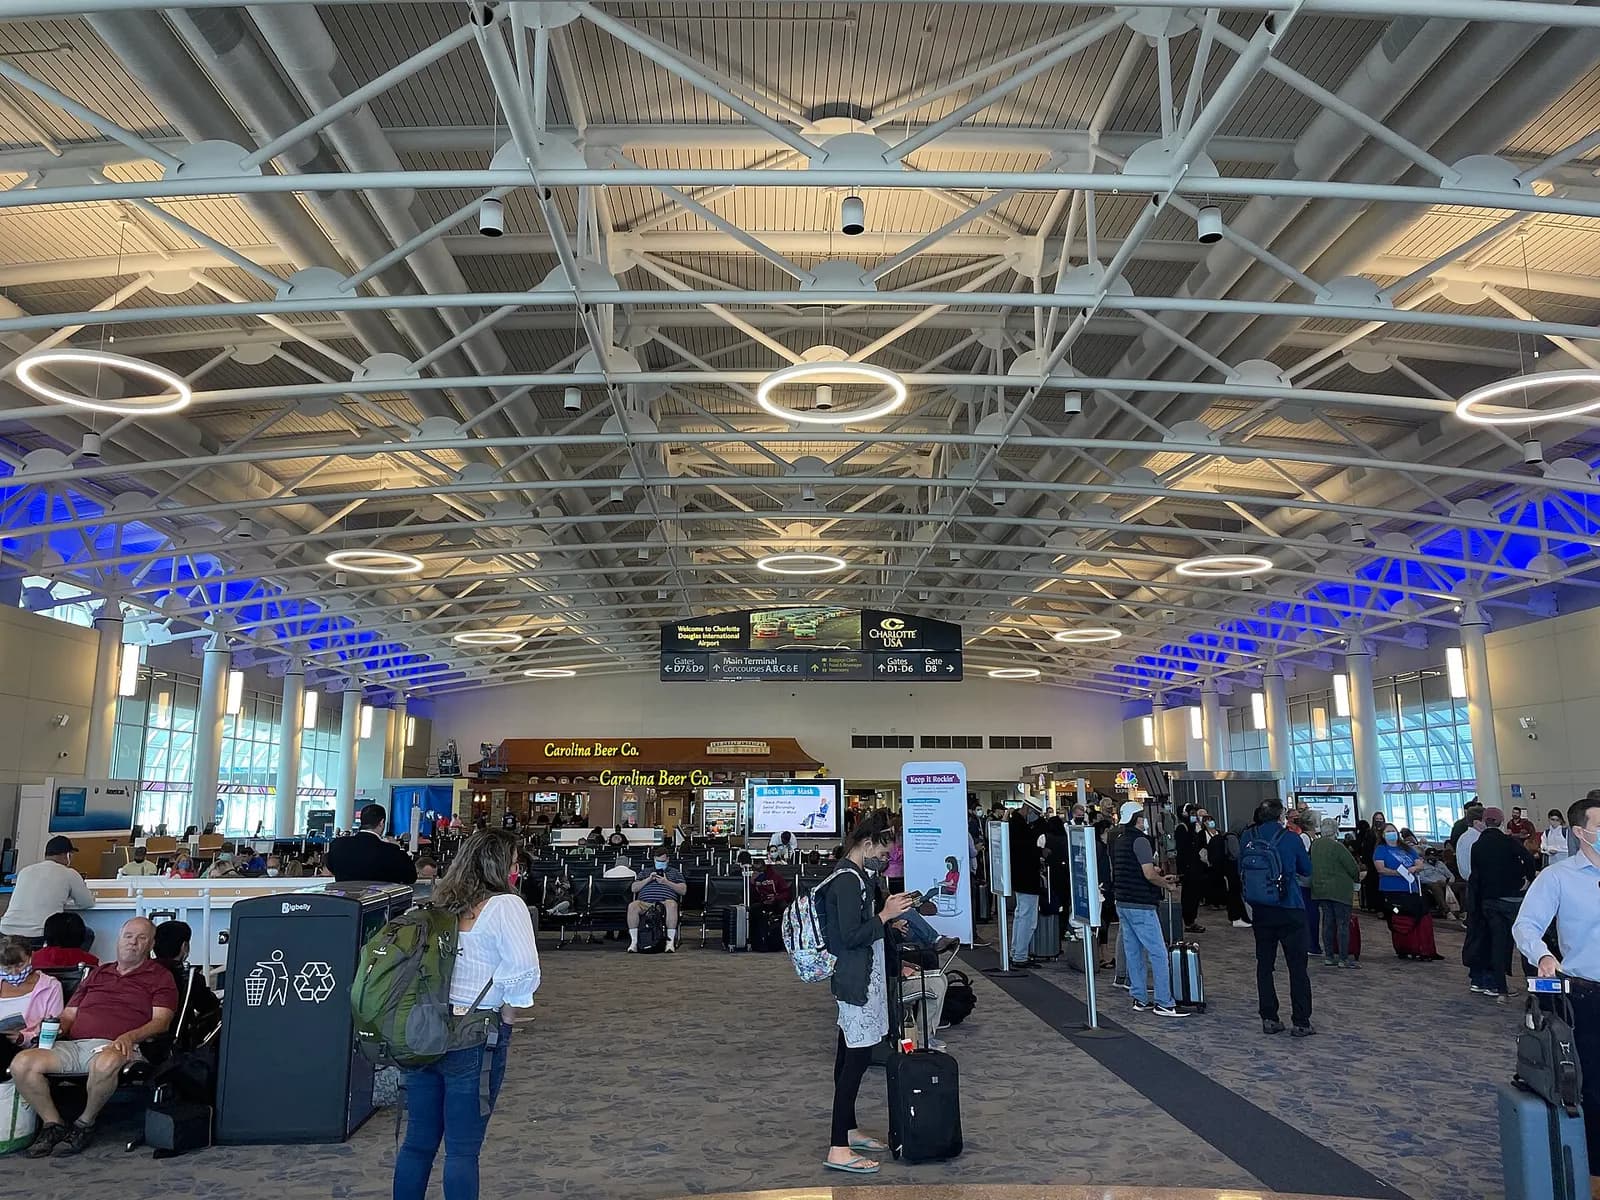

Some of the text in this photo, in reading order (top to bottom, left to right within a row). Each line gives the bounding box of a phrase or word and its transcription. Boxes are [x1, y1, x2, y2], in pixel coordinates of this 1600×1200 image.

[869, 629, 917, 639] CHARLOTTE
[883, 638, 903, 648] USA
[674, 657, 695, 665] Gates
[723, 657, 778, 665] Main Terminal
[887, 657, 908, 665] Gates
[925, 657, 943, 665] Gate
[544, 742, 640, 757] Carolina Beer Co.
[599, 769, 713, 786] Carolina Beer Co.
[910, 776, 926, 784] Keep
[765, 787, 814, 795] Rock Your Mask
[281, 902, 311, 914] Bigbelly
